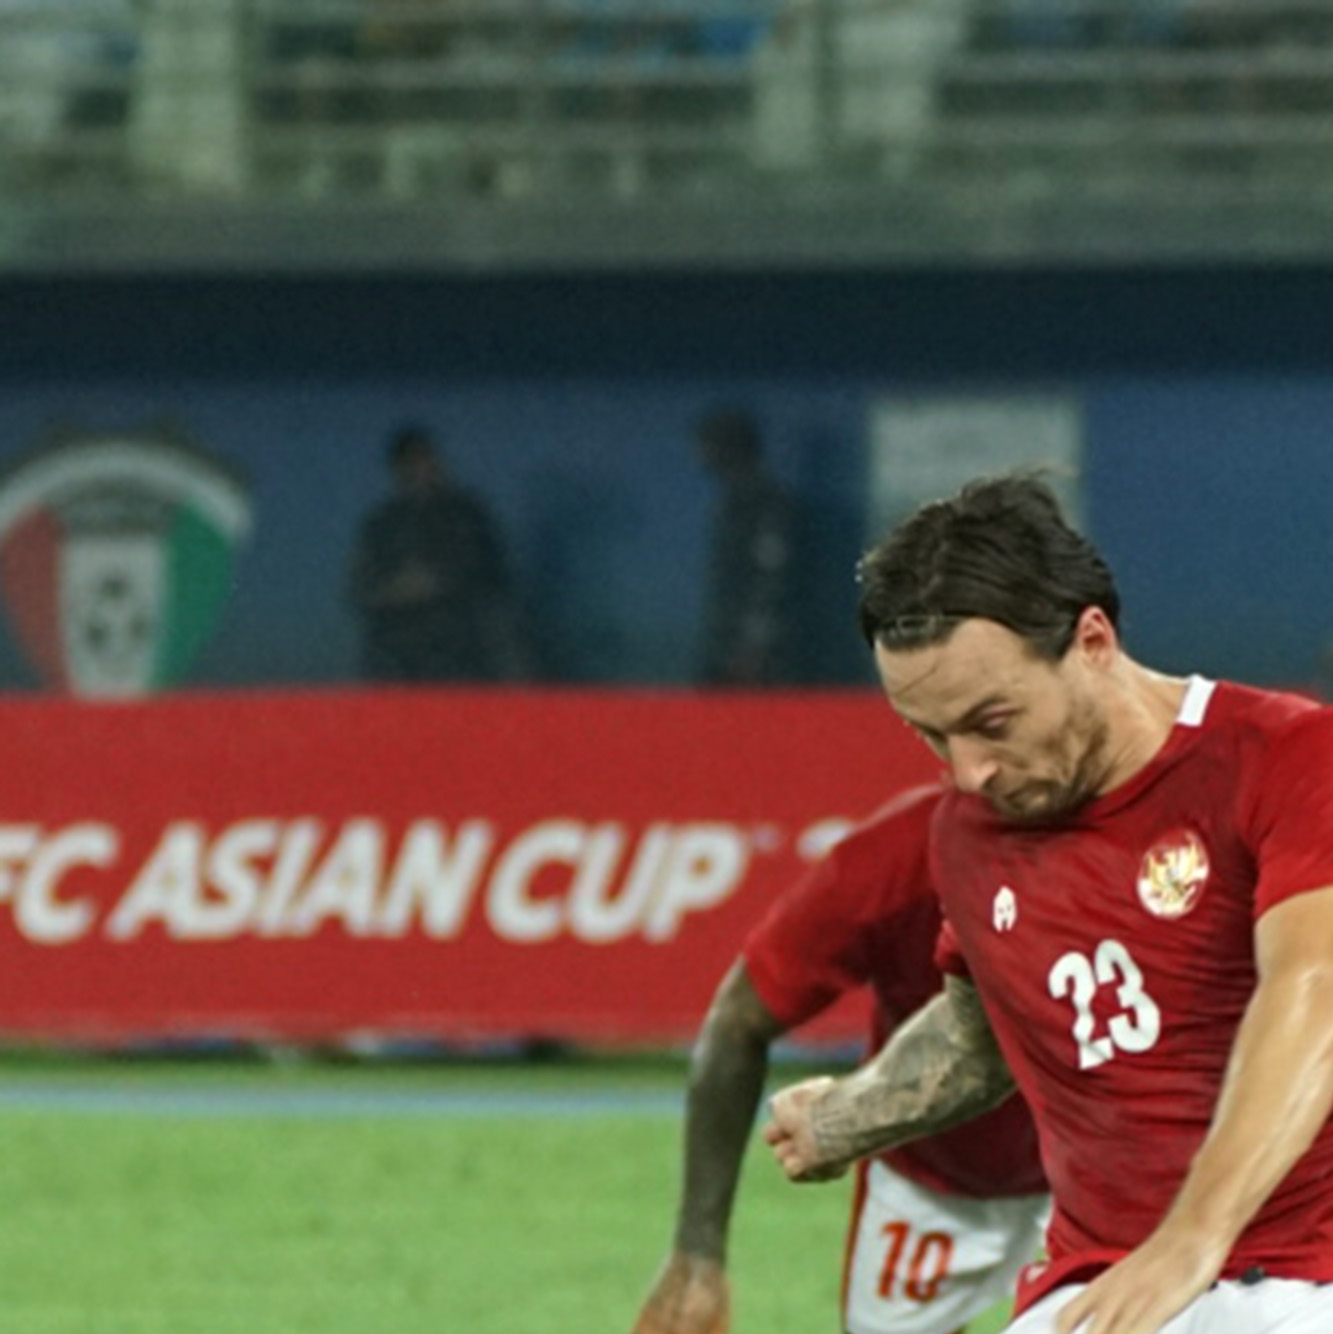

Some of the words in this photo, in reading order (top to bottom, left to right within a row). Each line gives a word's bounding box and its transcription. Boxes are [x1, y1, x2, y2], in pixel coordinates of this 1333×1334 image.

[106, 818, 491, 940] ASIAN
[485, 820, 749, 943] CUP
[1047, 938, 1162, 1071] 23
[877, 1220, 955, 1303] 10
